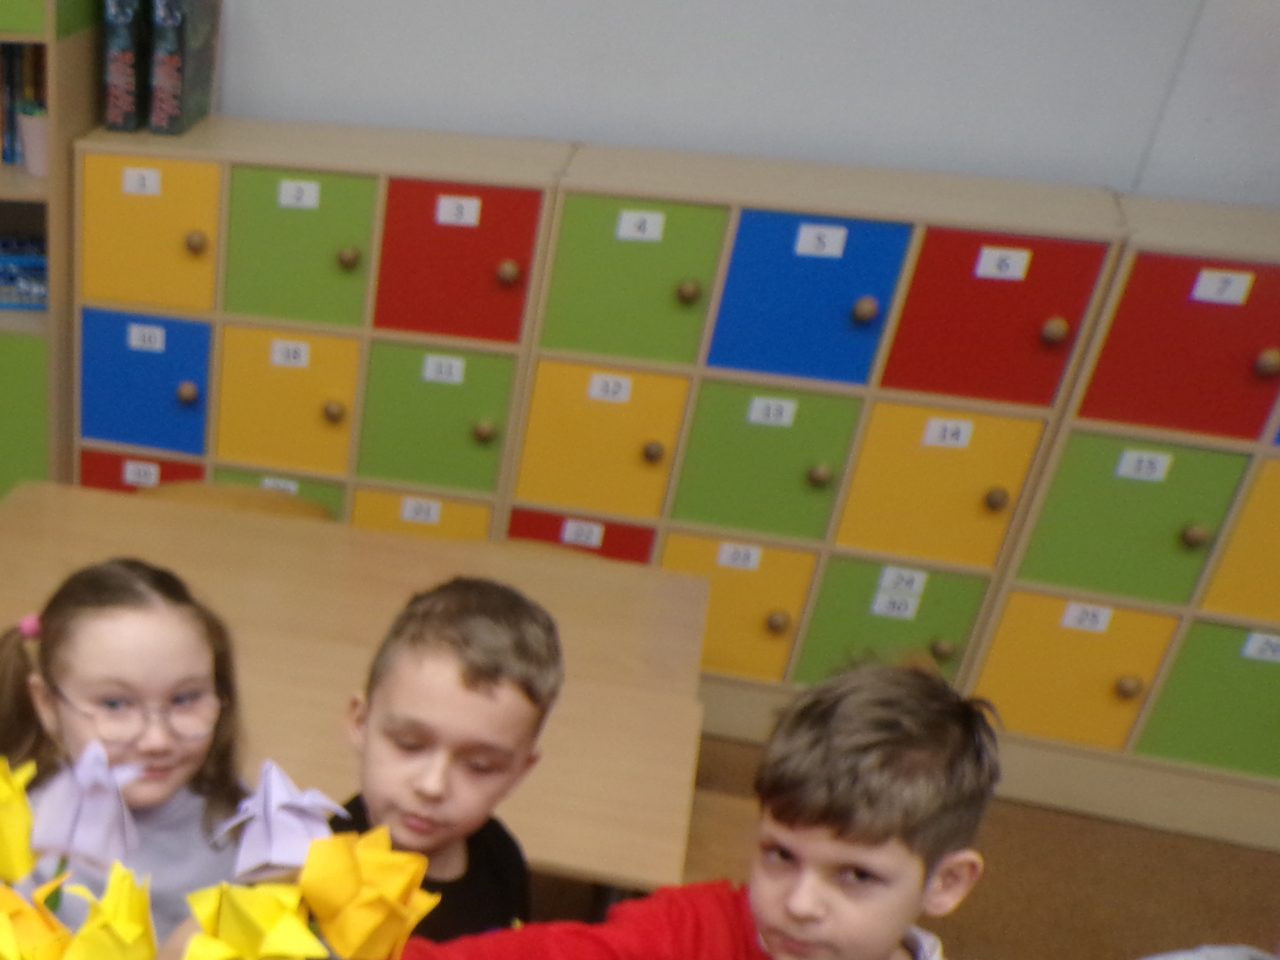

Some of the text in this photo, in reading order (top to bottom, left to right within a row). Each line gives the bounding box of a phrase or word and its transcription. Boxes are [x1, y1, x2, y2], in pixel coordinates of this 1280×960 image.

[600, 380, 622, 396] 12
[765, 403, 784, 420] 13
[939, 425, 961, 442] 14
[1135, 457, 1158, 478] 15
[892, 572, 915, 591] 24
[1077, 608, 1100, 626] 25
